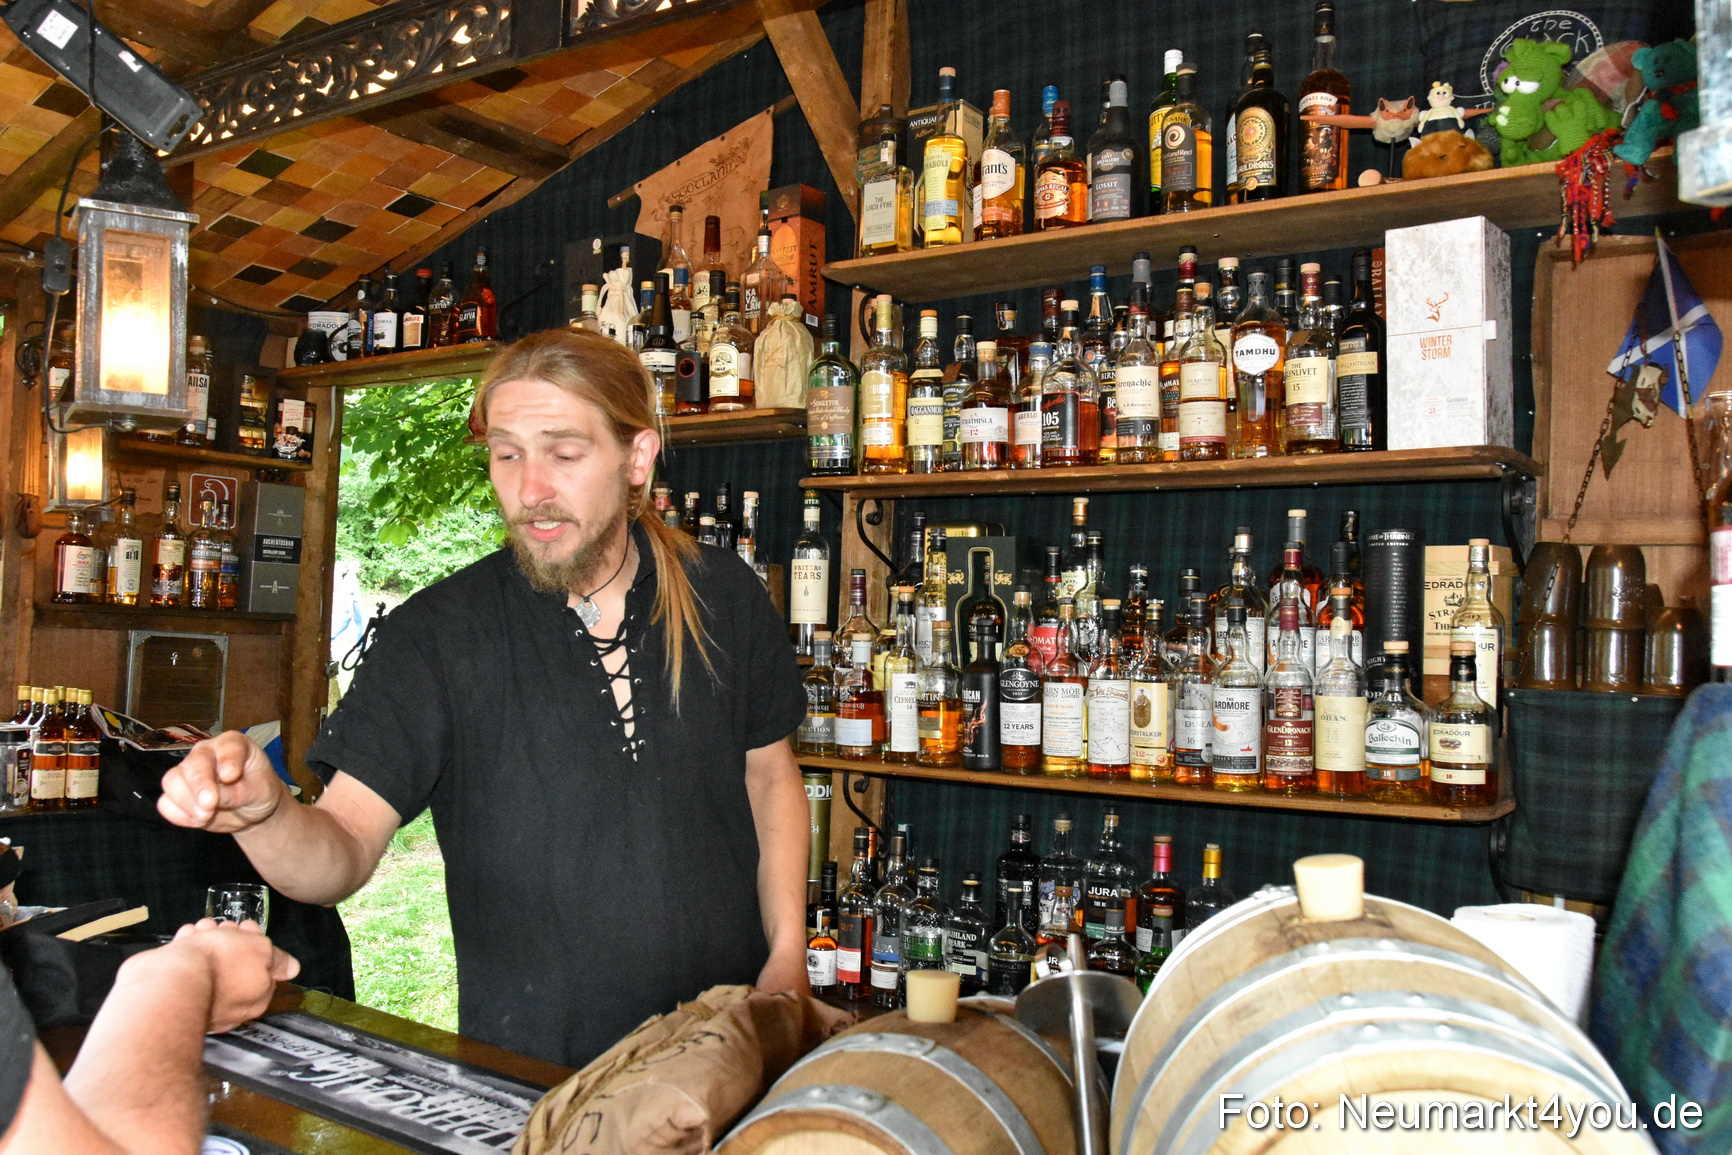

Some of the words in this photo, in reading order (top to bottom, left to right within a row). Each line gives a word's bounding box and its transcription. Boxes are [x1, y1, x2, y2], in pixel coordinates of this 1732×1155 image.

[1320, 95, 1333, 103] BOX
[981, 164, 1008, 178] rant's
[1049, 184, 1068, 193] REGAL
[1096, 181, 1119, 191] LOSSIT
[807, 243, 818, 311] AMRUT
[745, 288, 756, 297] KA
[1419, 334, 1453, 350] WINTER
[1235, 348, 1276, 358] TAMDHU
[1421, 346, 1452, 361] STORM
[1291, 362, 1302, 370] THE
[187, 375, 208, 389] AILSA
[1292, 383, 1301, 392] 15
[1107, 397, 1117, 410] Be
[1042, 411, 1060, 426] 105
[1142, 424, 1151, 432] 10
[793, 571, 822, 580] TEARS
[1000, 679, 1040, 689] GLENGOYNE
[894, 696, 916, 704] CLYNEL
[1214, 701, 1251, 711] ARDMORE
[1320, 714, 1347, 722] OBAN
[1011, 723, 1034, 731] YEARS
[1432, 728, 1472, 738] EDRADOUR
[1187, 736, 1196, 745] 16
[1368, 733, 1412, 747] Ballechin
[1087, 886, 1119, 898] JURA
